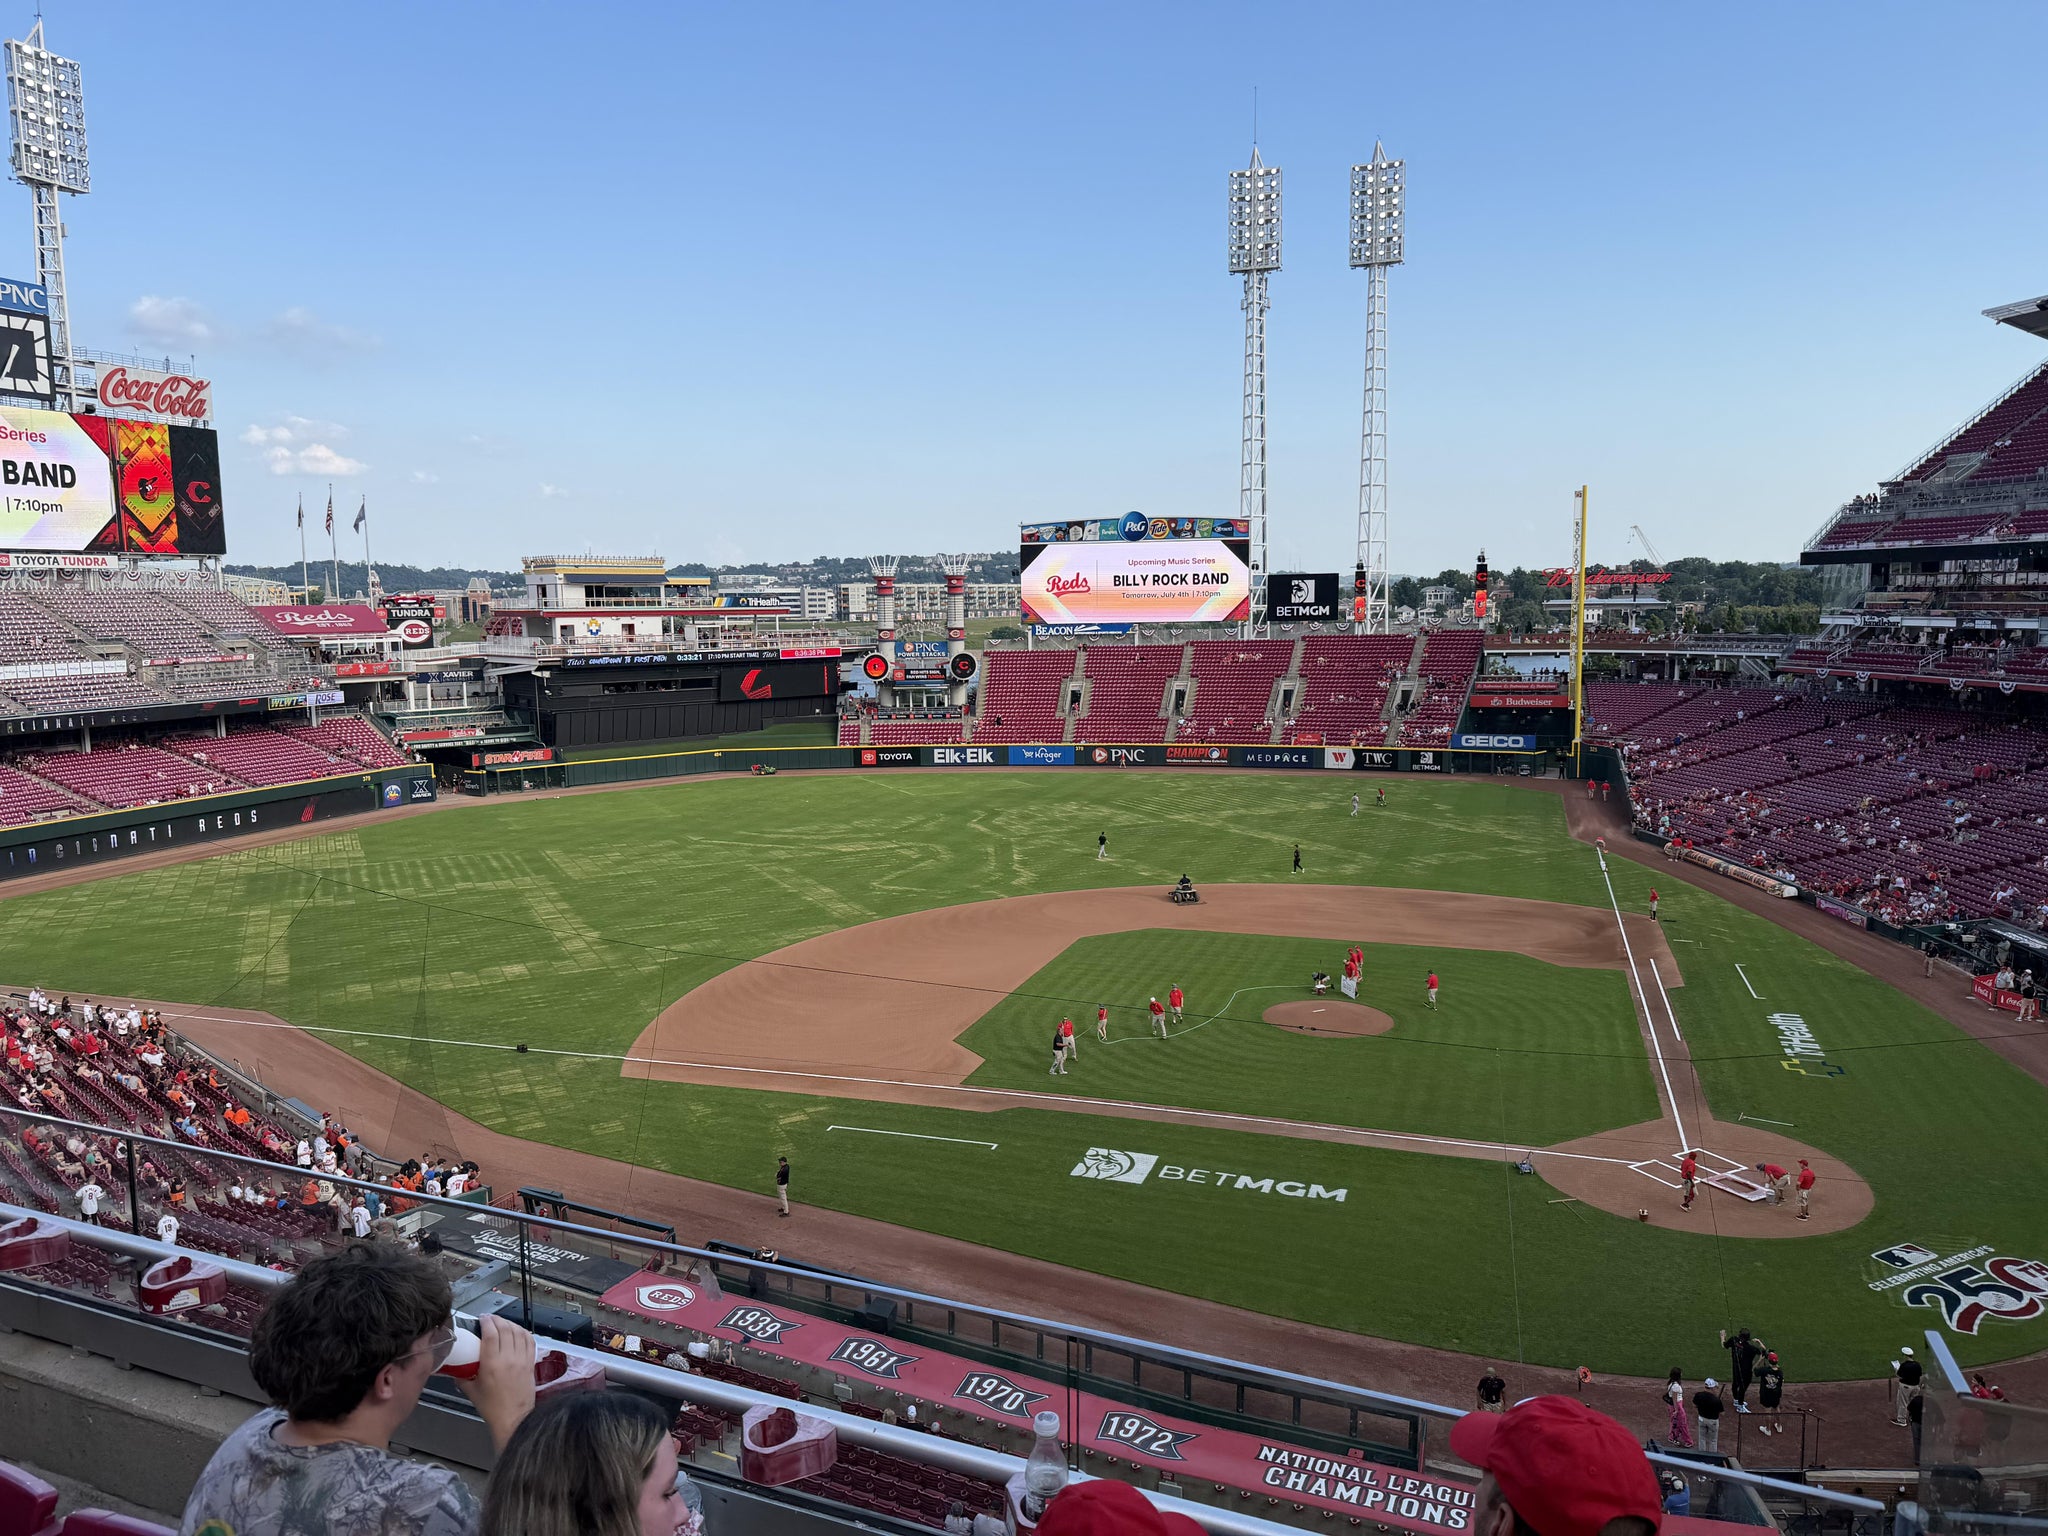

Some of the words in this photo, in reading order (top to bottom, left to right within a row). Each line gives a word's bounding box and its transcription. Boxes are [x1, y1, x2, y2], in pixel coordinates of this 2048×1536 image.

[0, 282, 46, 309] PNC
[100, 367, 211, 418] Coca-Cola
[0, 426, 47, 444] Series
[2, 459, 77, 489] BAND
[13, 498, 64, 514] 7:10pm
[1124, 521, 1147, 532] P&G
[1150, 523, 1168, 535] Tide
[14, 556, 60, 567] TOYOTA
[61, 556, 108, 567] TUNDRA
[1127, 559, 1166, 567] Upcoming
[1192, 557, 1216, 565] Series
[1113, 574, 1148, 587] BILLY
[1152, 573, 1188, 586] ROCK
[1192, 572, 1229, 585] BAND
[1542, 567, 1672, 588] Bdweiser
[1046, 572, 1091, 598] Reds
[747, 597, 780, 607] TriHealth
[1160, 591, 1176, 599] July
[275, 609, 355, 627] Reds
[390, 609, 431, 617] TUNDRA
[1276, 606, 1330, 617] BETMGM
[405, 627, 431, 635] REDS
[1035, 625, 1074, 636] BEACON
[914, 642, 939, 652] PNC
[315, 692, 336, 705] ROSE
[1505, 697, 1553, 706] Budweiser
[1461, 735, 1525, 748] GEICO
[484, 754, 513, 765] STAR
[519, 750, 545, 762] FIRE
[878, 753, 913, 761] TOYOTA
[1034, 750, 1062, 762] Kroger
[1110, 749, 1145, 763] PNC
[1246, 752, 1308, 763] MEDPACE
[1362, 752, 1393, 764] TWC
[1412, 763, 1441, 771] BETMGM
[199, 810, 258, 833] REDS
[1158, 1165, 1349, 1202] BETMGM
[1868, 1263, 1943, 1292] CELEBRATING
[1937, 1245, 1996, 1272] AMERICA'S
[650, 1290, 690, 1306] REDS
[727, 1308, 782, 1338] 1939
[841, 1340, 899, 1372] 1961
[964, 1375, 1024, 1411] 1970
[1107, 1415, 1173, 1453] 1972
[1258, 1445, 1377, 1487] NATIONAL
[1386, 1474, 1476, 1509] LEAGU
[1265, 1466, 1469, 1530] CHAMPIONS
